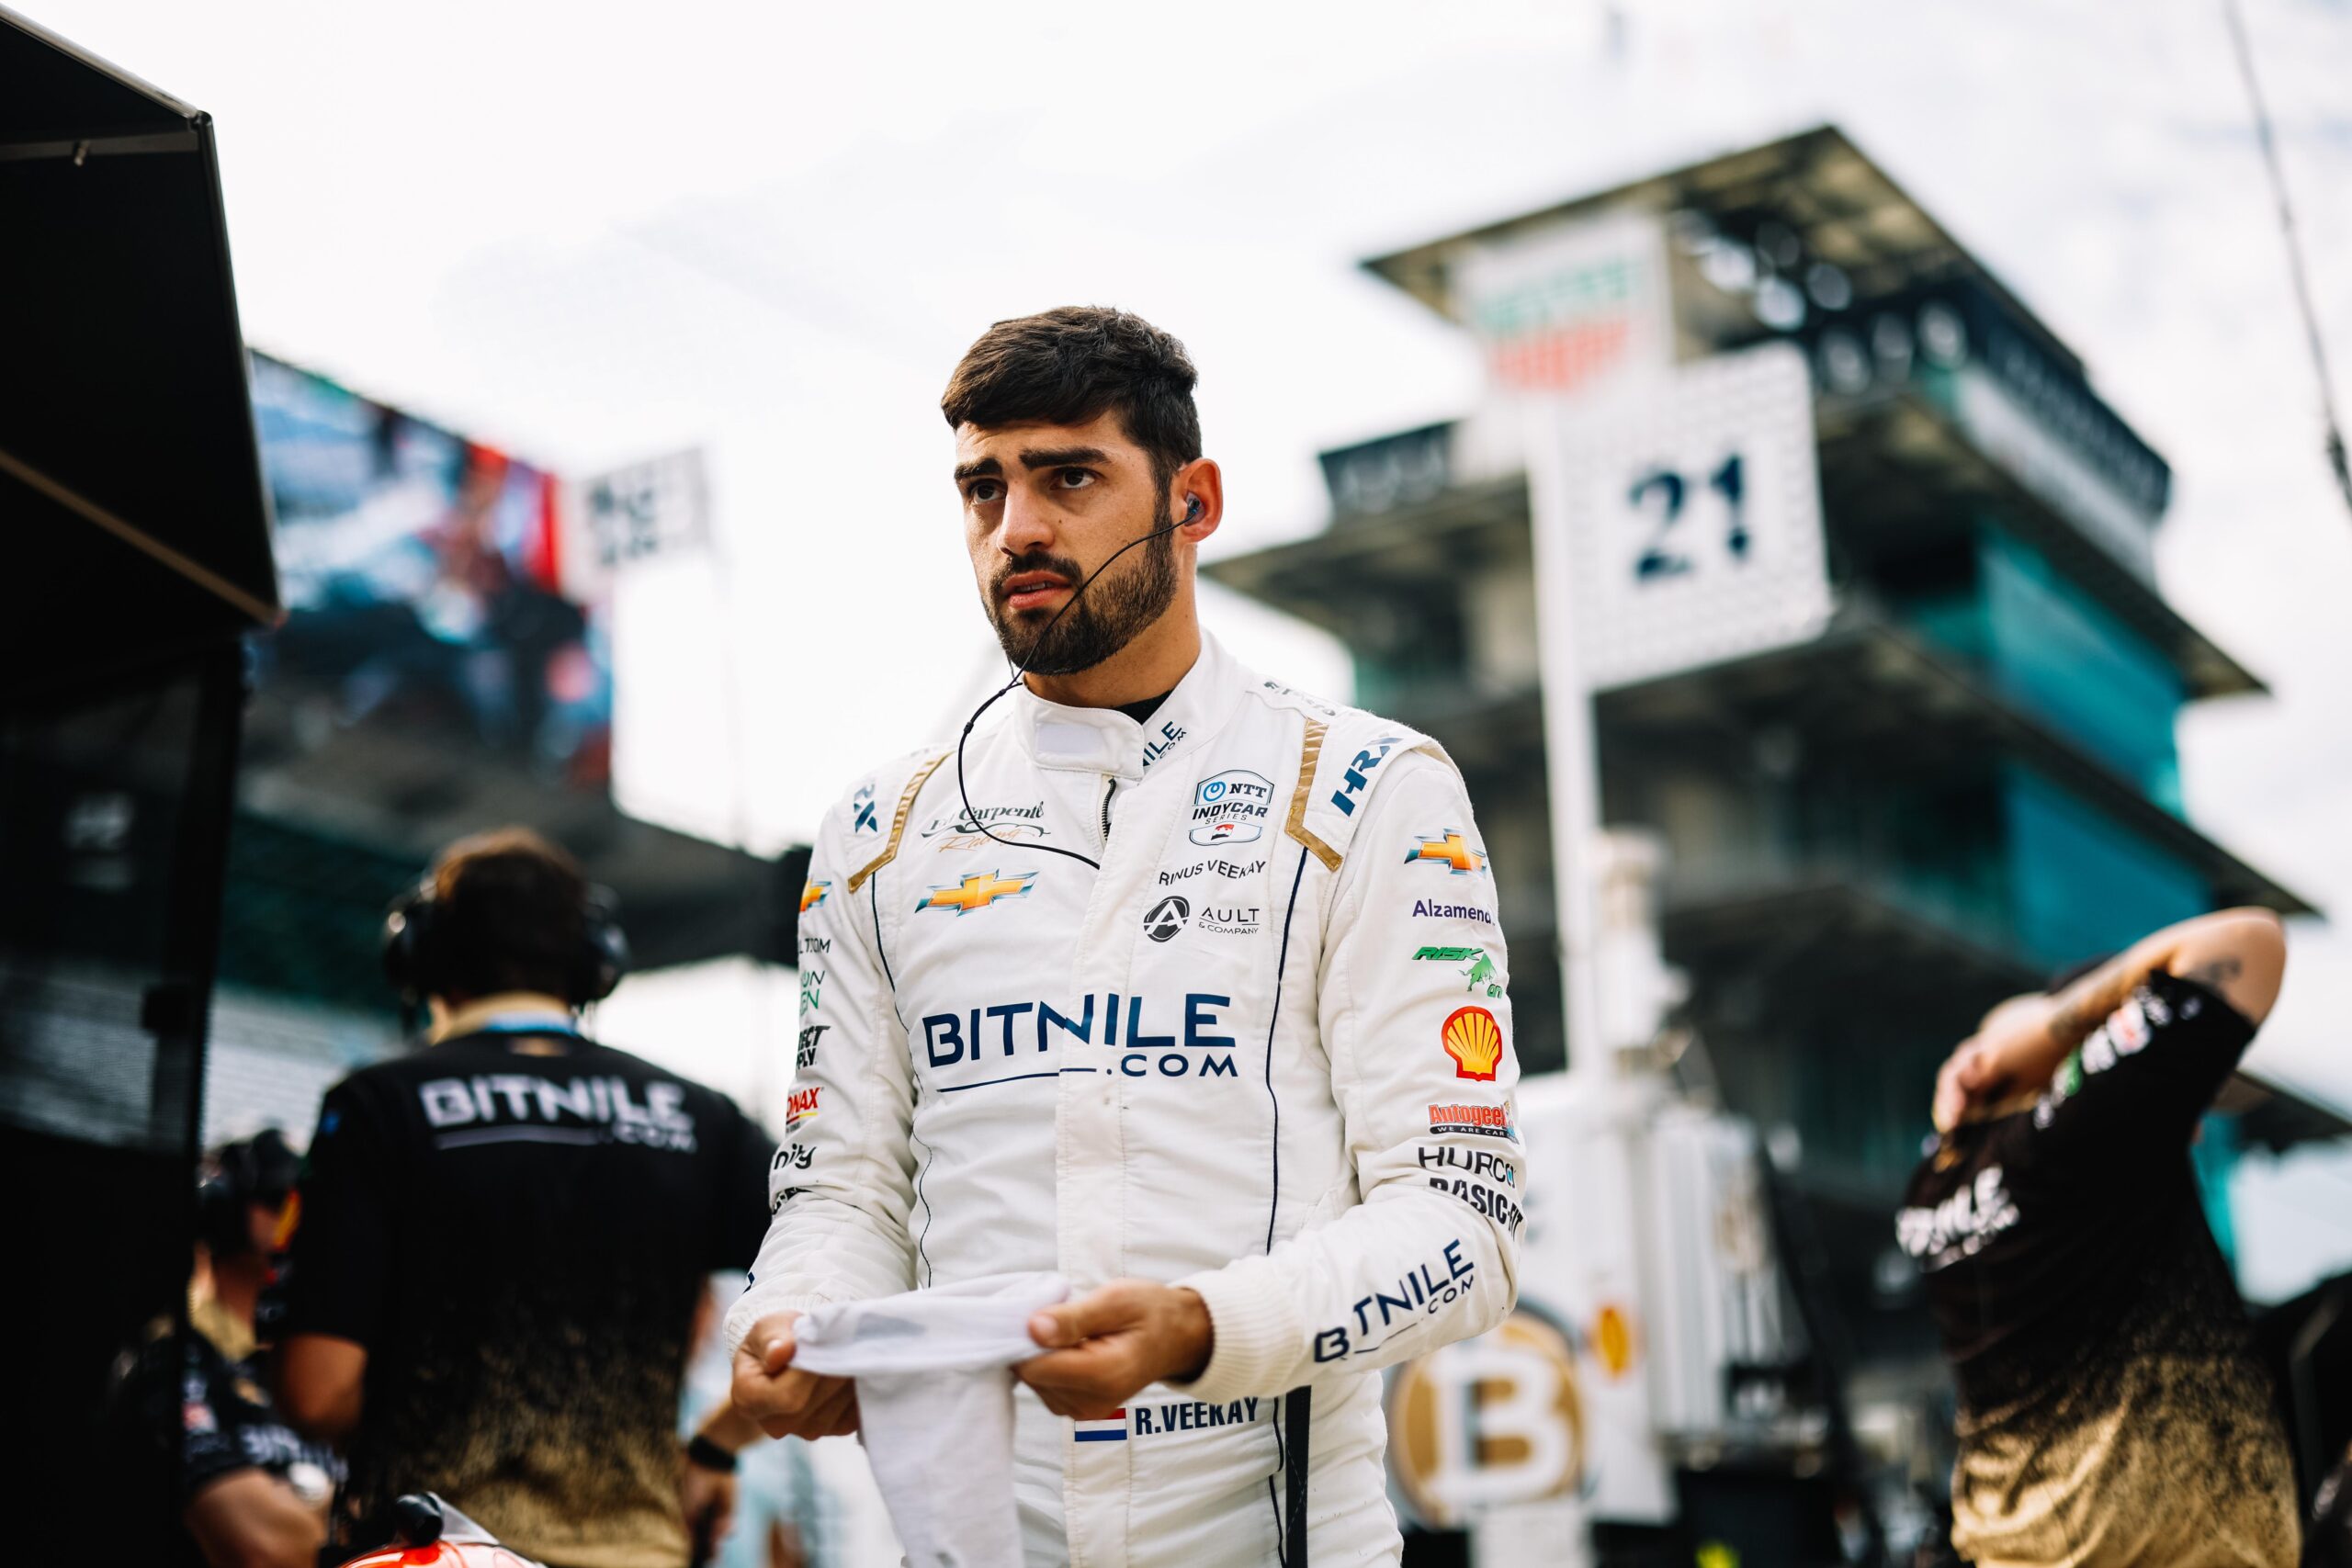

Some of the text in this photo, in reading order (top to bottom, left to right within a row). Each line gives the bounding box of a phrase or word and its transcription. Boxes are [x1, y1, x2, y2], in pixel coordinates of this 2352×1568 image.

[1630, 454, 1752, 588] 21
[1228, 783, 1267, 798] NTT
[1192, 802, 1268, 820] INDYCAR
[1204, 813, 1248, 825] SERIES
[1158, 859, 1267, 886] RINUS VEEKAY
[1201, 906, 1261, 923] AULT
[1206, 924, 1260, 935] COMPANY
[1412, 946, 1485, 961] RISK
[922, 993, 1237, 1068] BITNILE
[1106, 1054, 1238, 1077] .COM
[419, 1073, 694, 1134] BITNILE
[1485, 1129, 1505, 1137] CAR
[1314, 1238, 1475, 1362] BTNILE
[1136, 1396, 1259, 1436] R.VEEKAY
